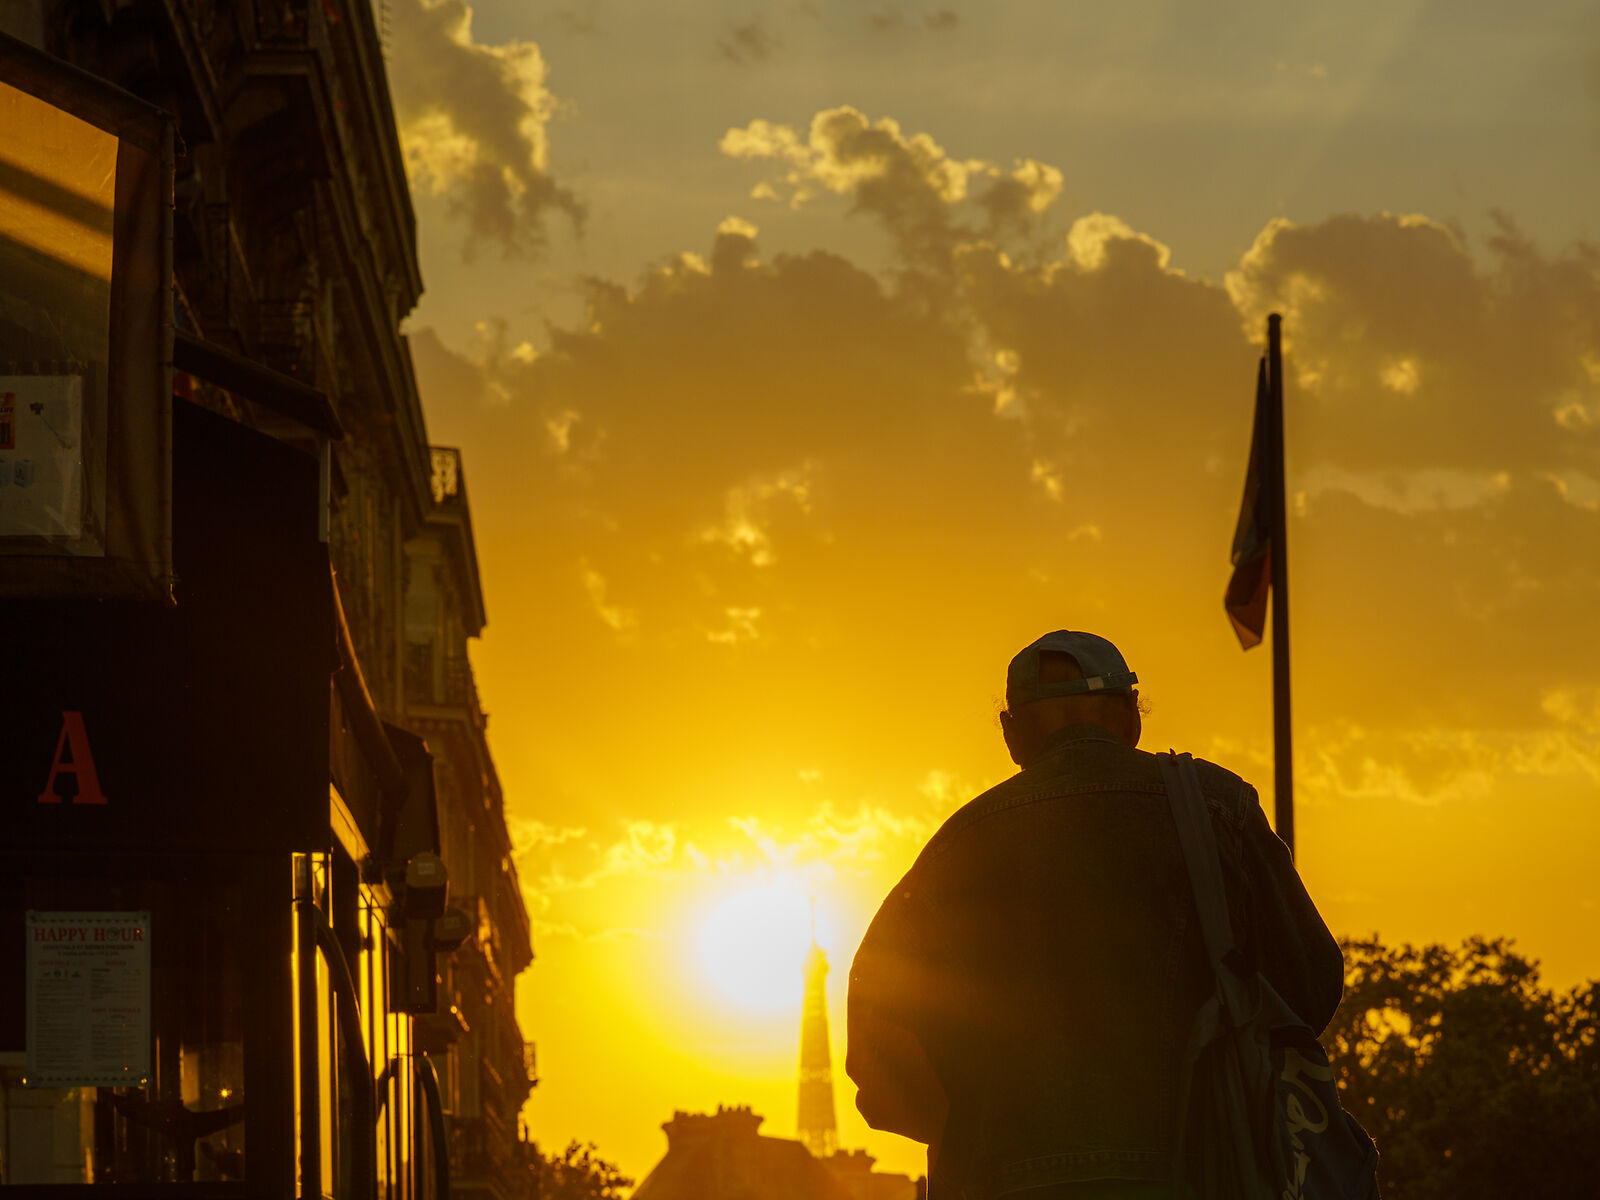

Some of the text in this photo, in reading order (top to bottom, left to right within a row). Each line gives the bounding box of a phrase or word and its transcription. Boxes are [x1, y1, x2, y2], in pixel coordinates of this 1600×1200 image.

[37, 710, 109, 806] A
[34, 927, 145, 942] HAPPY HOUR
